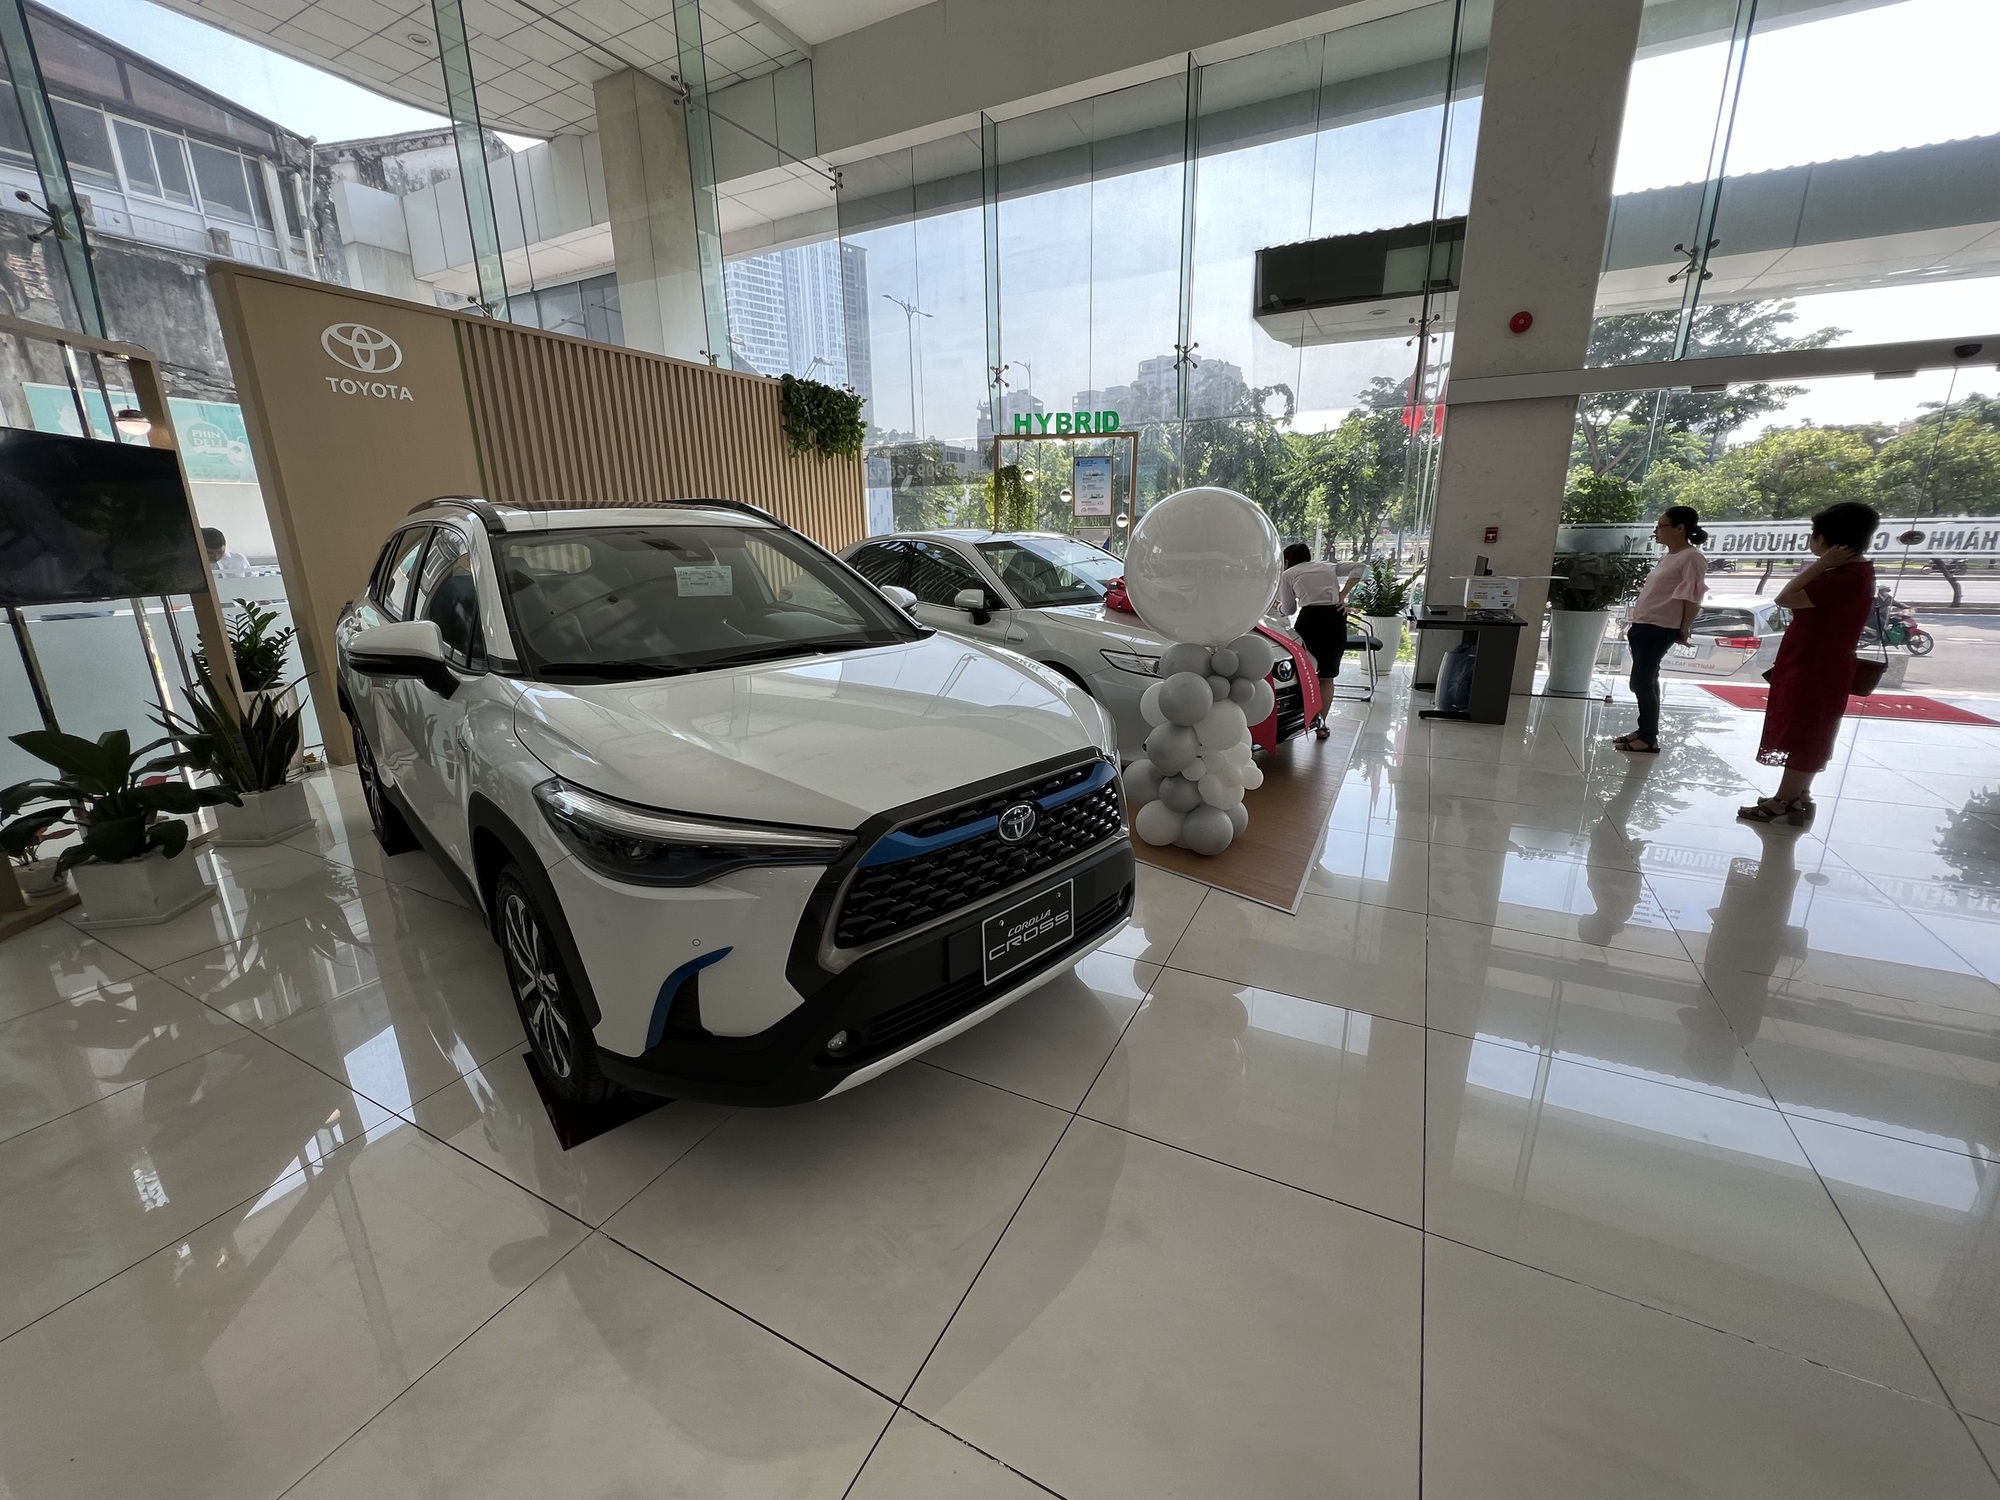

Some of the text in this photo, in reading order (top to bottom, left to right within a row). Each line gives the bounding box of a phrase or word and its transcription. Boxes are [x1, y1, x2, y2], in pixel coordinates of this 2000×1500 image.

[325, 377, 414, 401] TOYOTA
[191, 429, 221, 438] PHIN
[1014, 411, 1120, 435] HYBRID
[988, 910, 1069, 961] CROSS
[1007, 909, 1051, 938] COROLLA
